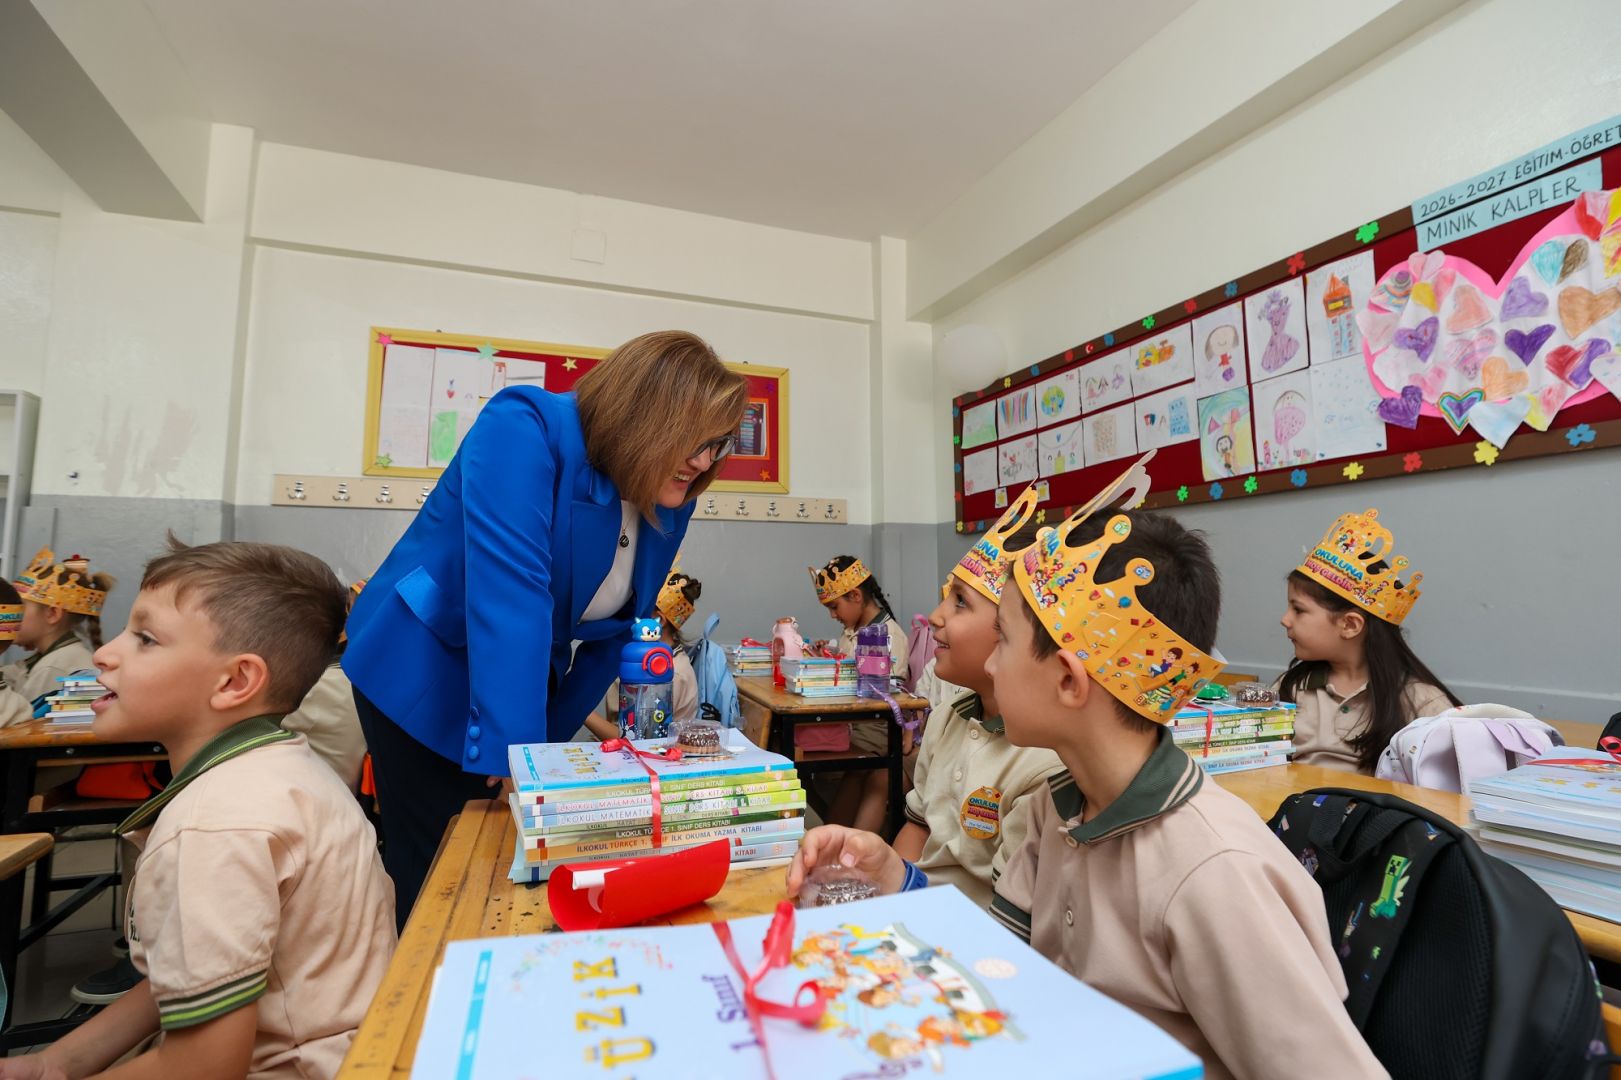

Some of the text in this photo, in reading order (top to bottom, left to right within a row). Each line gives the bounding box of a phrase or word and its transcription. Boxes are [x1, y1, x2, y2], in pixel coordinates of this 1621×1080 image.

[1421, 171, 1506, 218] 2026-2027
[1492, 176, 1582, 221] KALPLER
[1314, 548, 1364, 581] OKULUNA
[599, 796, 649, 808] MATEMATİK
[600, 809, 650, 821] MATEMATİK
[577, 842, 608, 853] İLKOKUL
[610, 839, 637, 850] TÜRKÇE
[671, 834, 682, 842] İLK
[685, 832, 711, 840] OKUMA
[713, 829, 737, 837] YAZMA
[741, 824, 763, 833] KİTABI
[616, 829, 642, 838] İLKOKUL
[677, 823, 694, 831] SINIF
[695, 820, 711, 829] DERS
[712, 818, 731, 827] KİTABI
[734, 848, 757, 857] KİTABI
